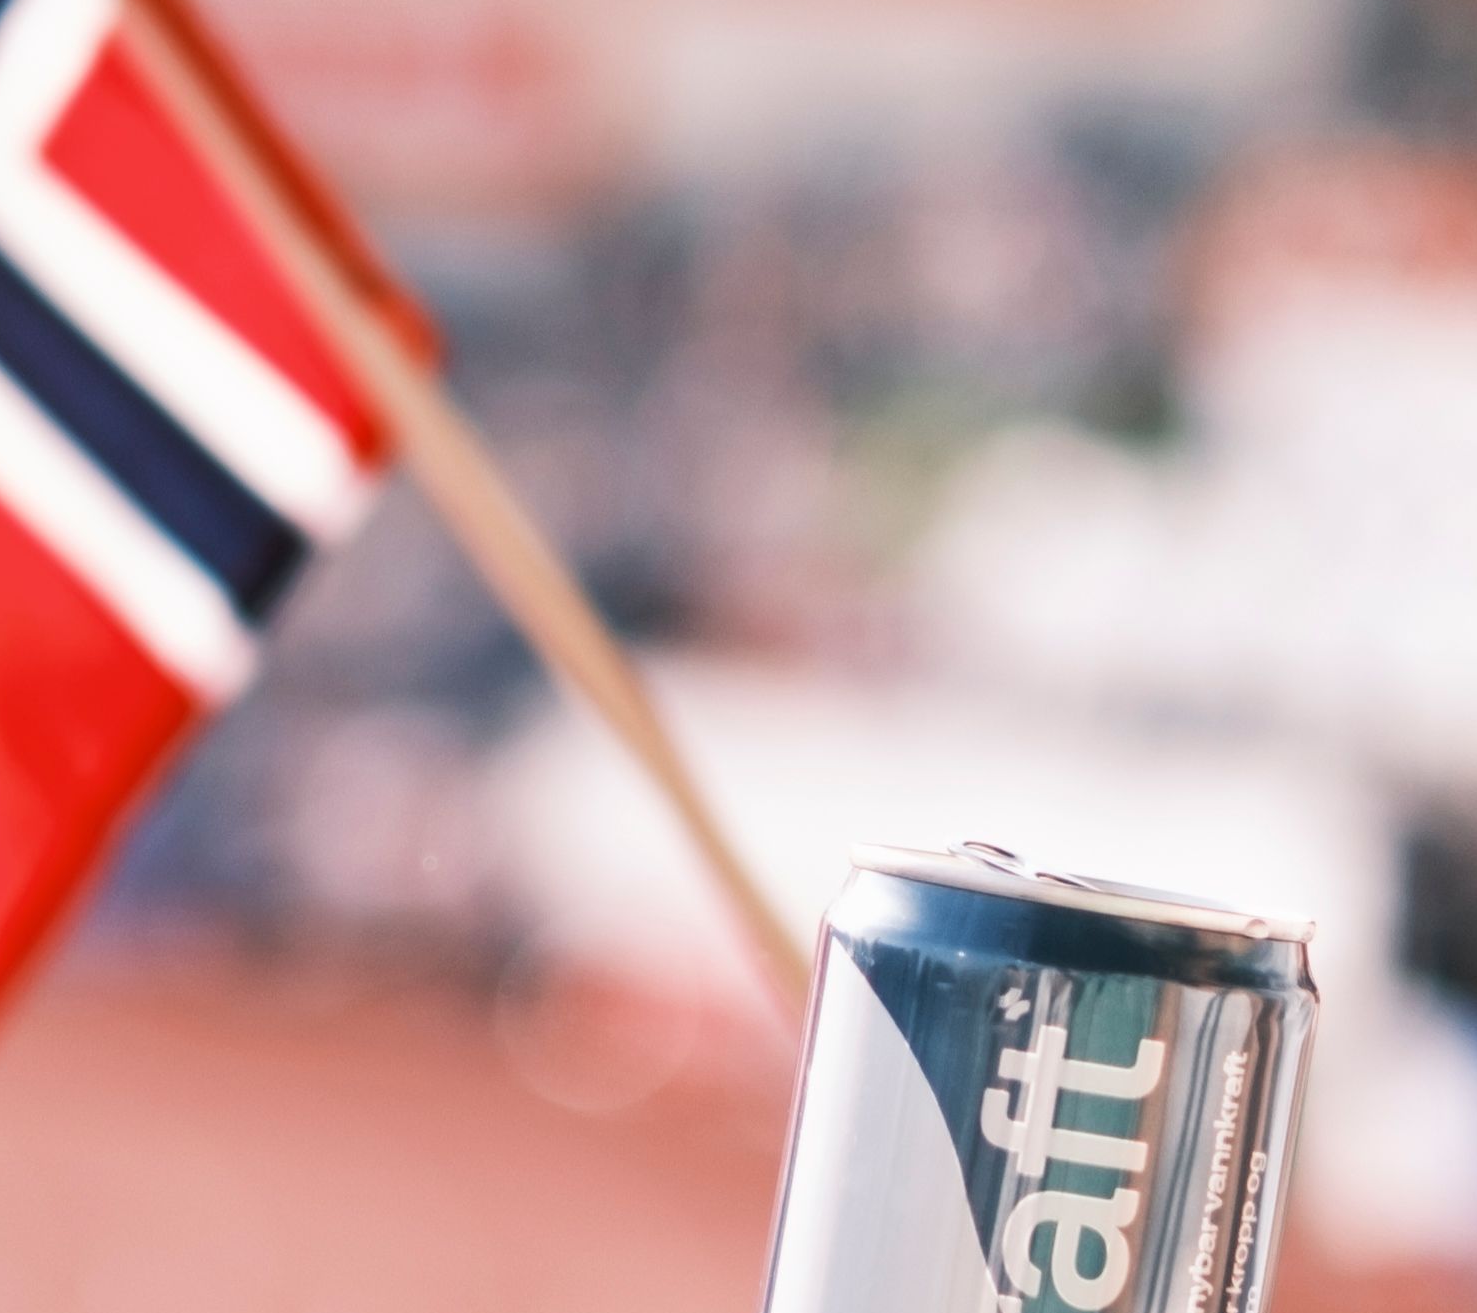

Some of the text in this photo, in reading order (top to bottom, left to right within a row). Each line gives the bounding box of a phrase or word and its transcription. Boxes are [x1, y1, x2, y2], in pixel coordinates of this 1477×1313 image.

[1204, 1050, 1249, 1213] vannkraft
[1226, 1200, 1257, 1294] kropp
[1247, 1151, 1266, 1194] og
